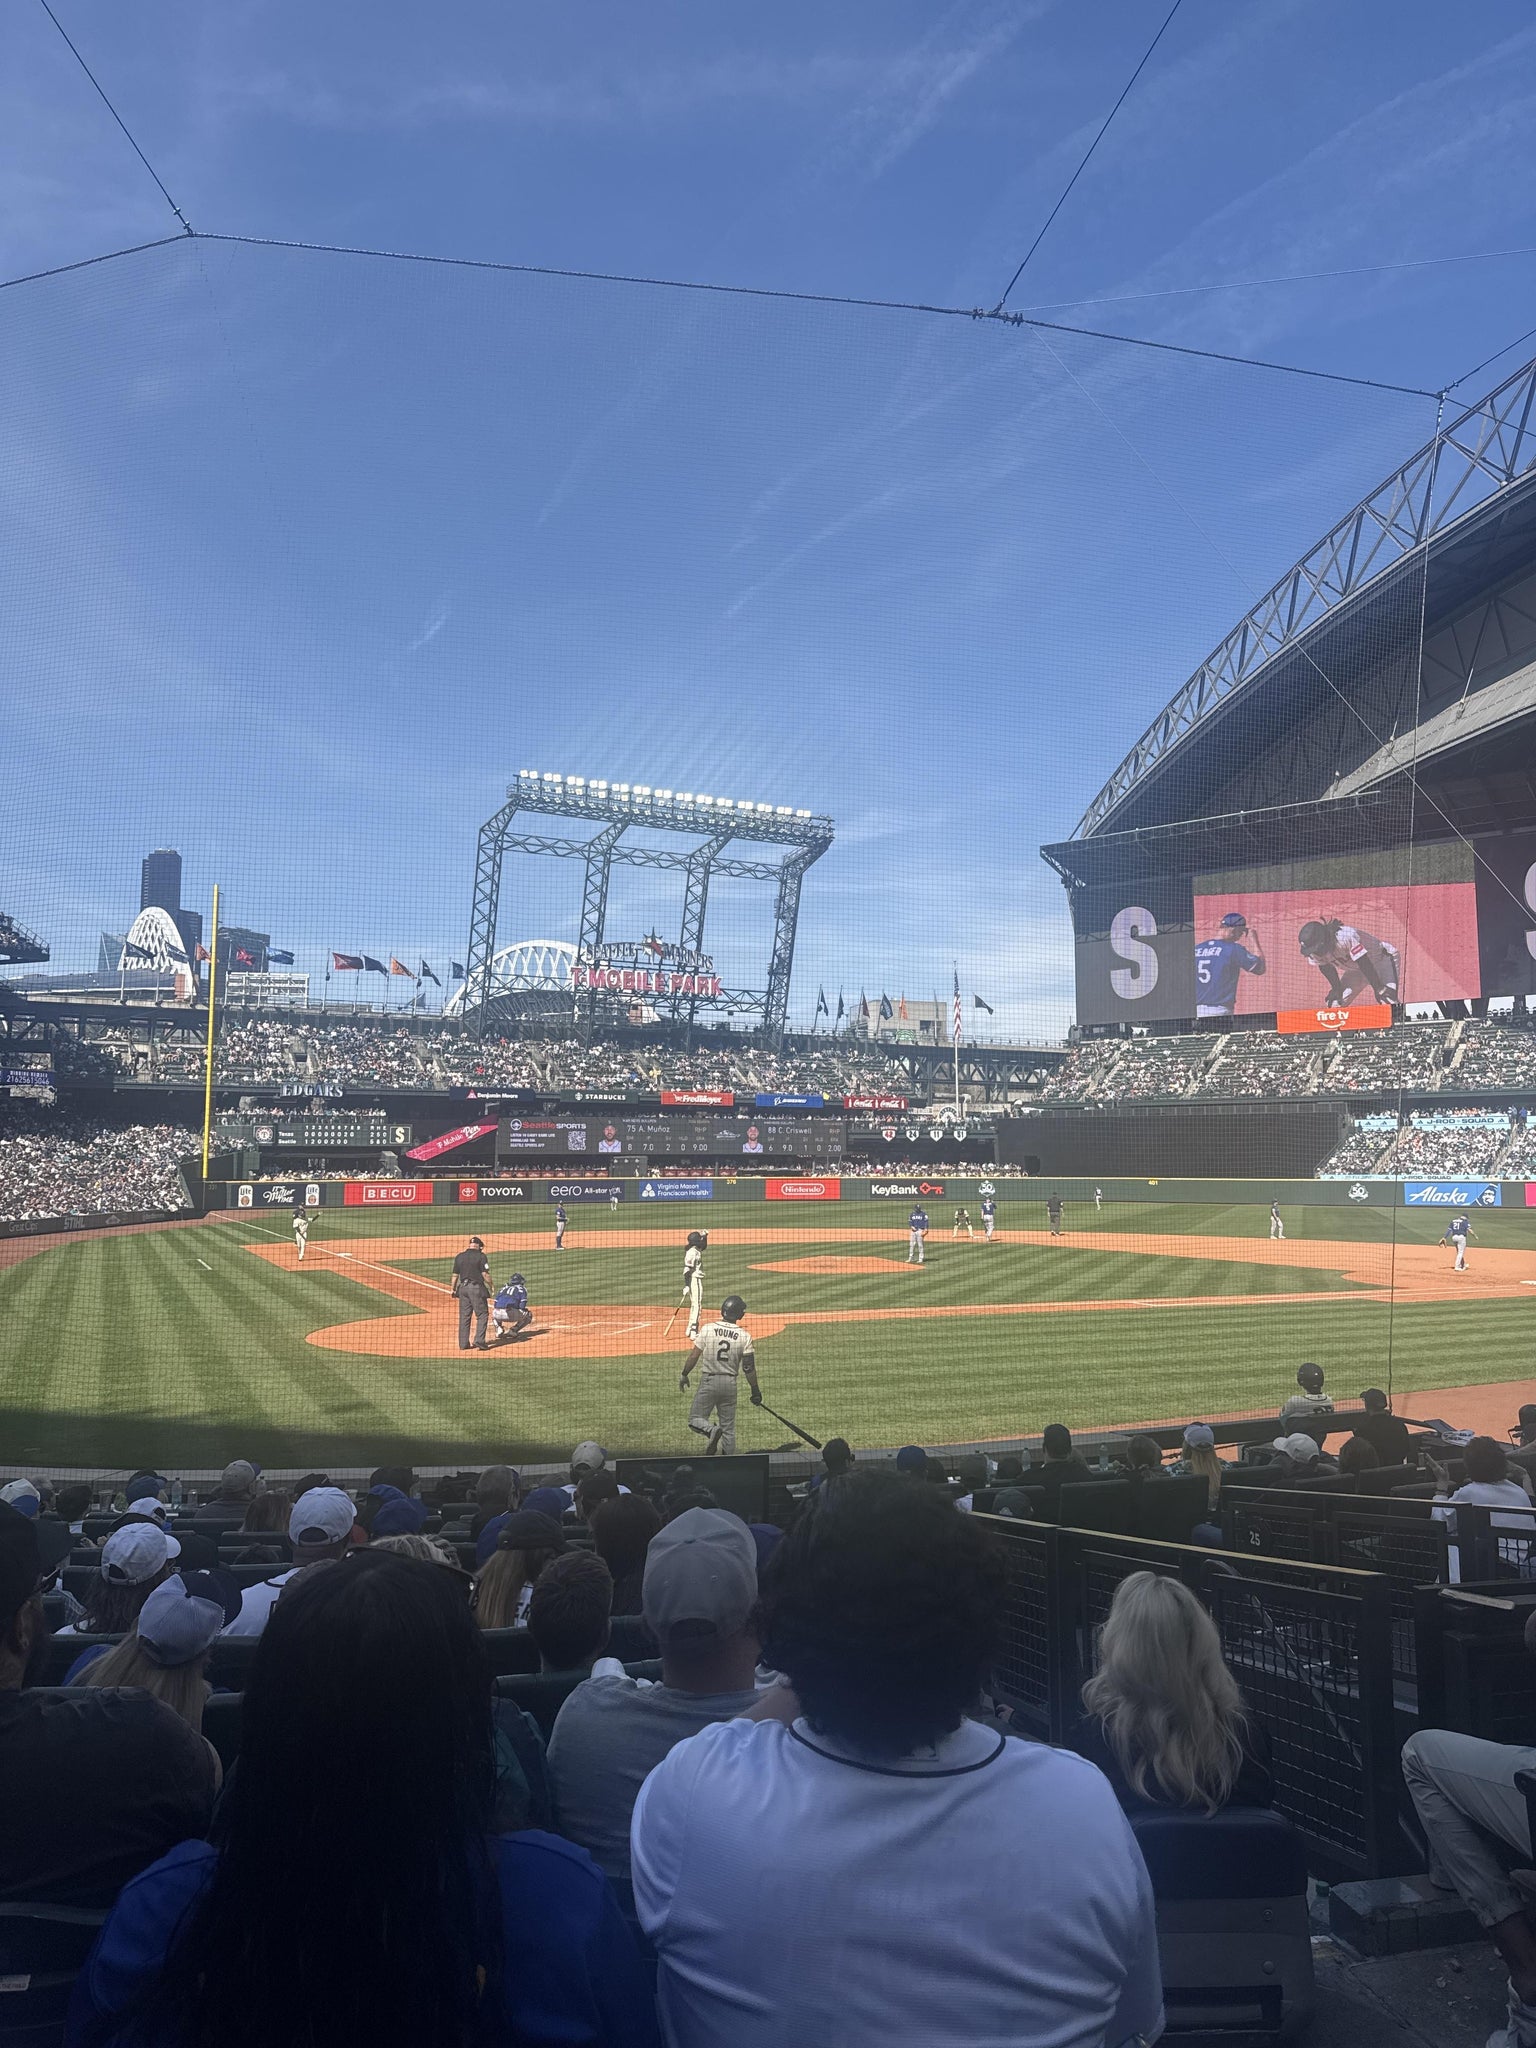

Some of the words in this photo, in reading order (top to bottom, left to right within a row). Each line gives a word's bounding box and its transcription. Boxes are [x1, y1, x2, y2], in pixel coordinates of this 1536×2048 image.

[586, 941, 636, 960] SEATTLE
[663, 943, 714, 971] MARINERS
[1110, 906, 1159, 1000] S
[1198, 960, 1211, 984] 5
[571, 966, 666, 993] T-MOBILE
[669, 973, 723, 997] PARK
[1316, 1010, 1336, 1021] fire
[1337, 1010, 1350, 1020] tv
[282, 1084, 344, 1098] EDGARS
[522, 1121, 556, 1129] Seattle
[627, 1125, 636, 1133] 75
[786, 1126, 812, 1134] Criswell
[395, 1127, 405, 1144] S
[240, 1186, 252, 1196] Lite
[263, 1189, 296, 1203] Miller
[308, 1186, 318, 1195] Lite
[481, 1188, 523, 1196] TOYOTA
[551, 1185, 582, 1197] eero
[872, 1185, 918, 1196] KeyBank
[1352, 1187, 1365, 1195] 50
[1409, 1186, 1469, 1204] Alaska
[64, 1217, 86, 1229] STIHL
[1453, 1222, 1460, 1230] 21
[714, 1328, 739, 1340] YOUNG
[717, 1340, 730, 1362] 2
[1250, 1530, 1260, 1546] 25
